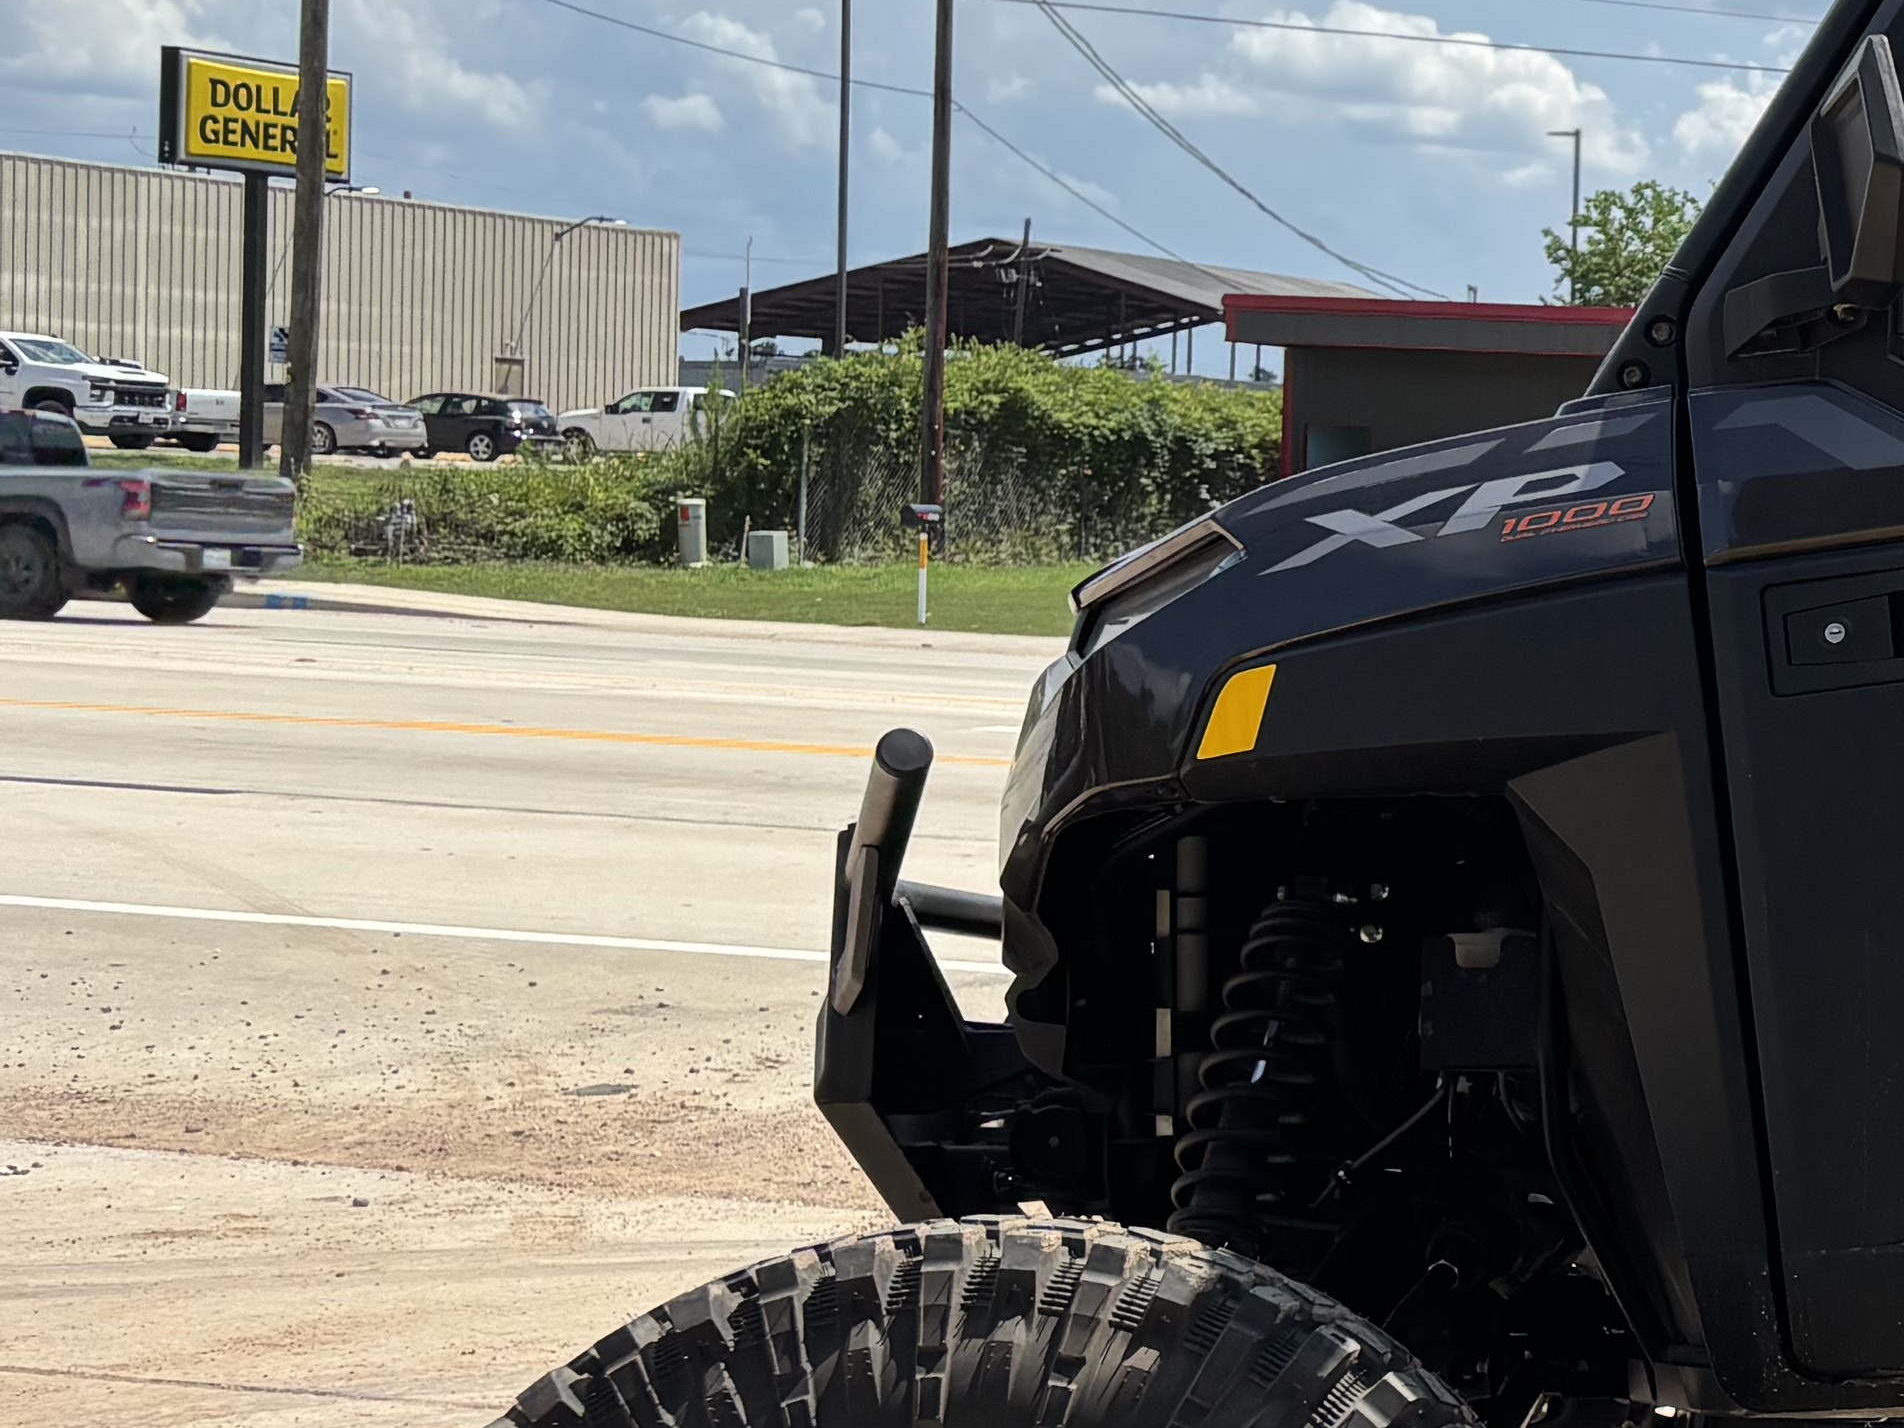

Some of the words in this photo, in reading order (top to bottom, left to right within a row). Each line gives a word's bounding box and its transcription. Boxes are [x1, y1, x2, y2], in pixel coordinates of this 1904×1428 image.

[199, 115, 338, 159] GENERL
[1258, 461, 1626, 576] XP
[1502, 493, 1655, 535] 1000
